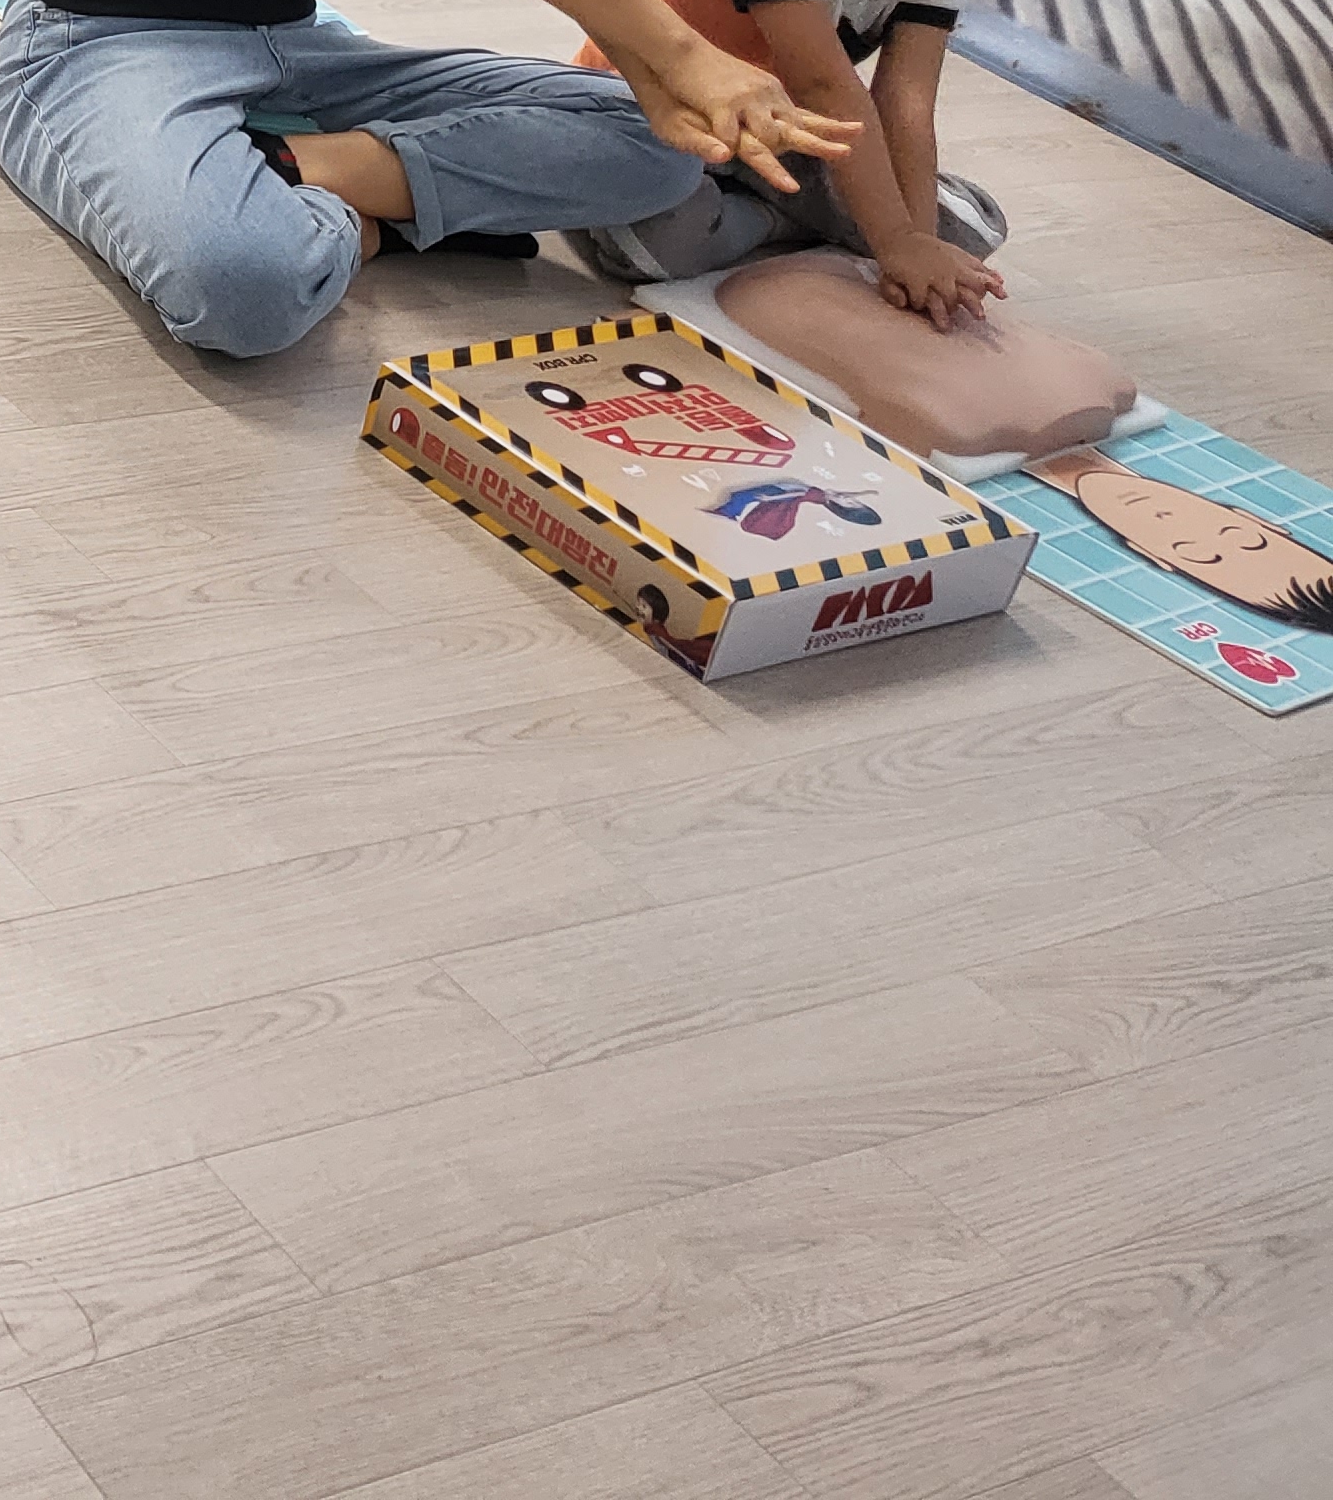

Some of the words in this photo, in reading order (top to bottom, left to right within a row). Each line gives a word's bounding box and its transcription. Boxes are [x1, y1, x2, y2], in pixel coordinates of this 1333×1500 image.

[534, 357, 569, 371] BOX
[478, 466, 618, 586] 안전대행진
[1176, 622, 1218, 640] CPR
